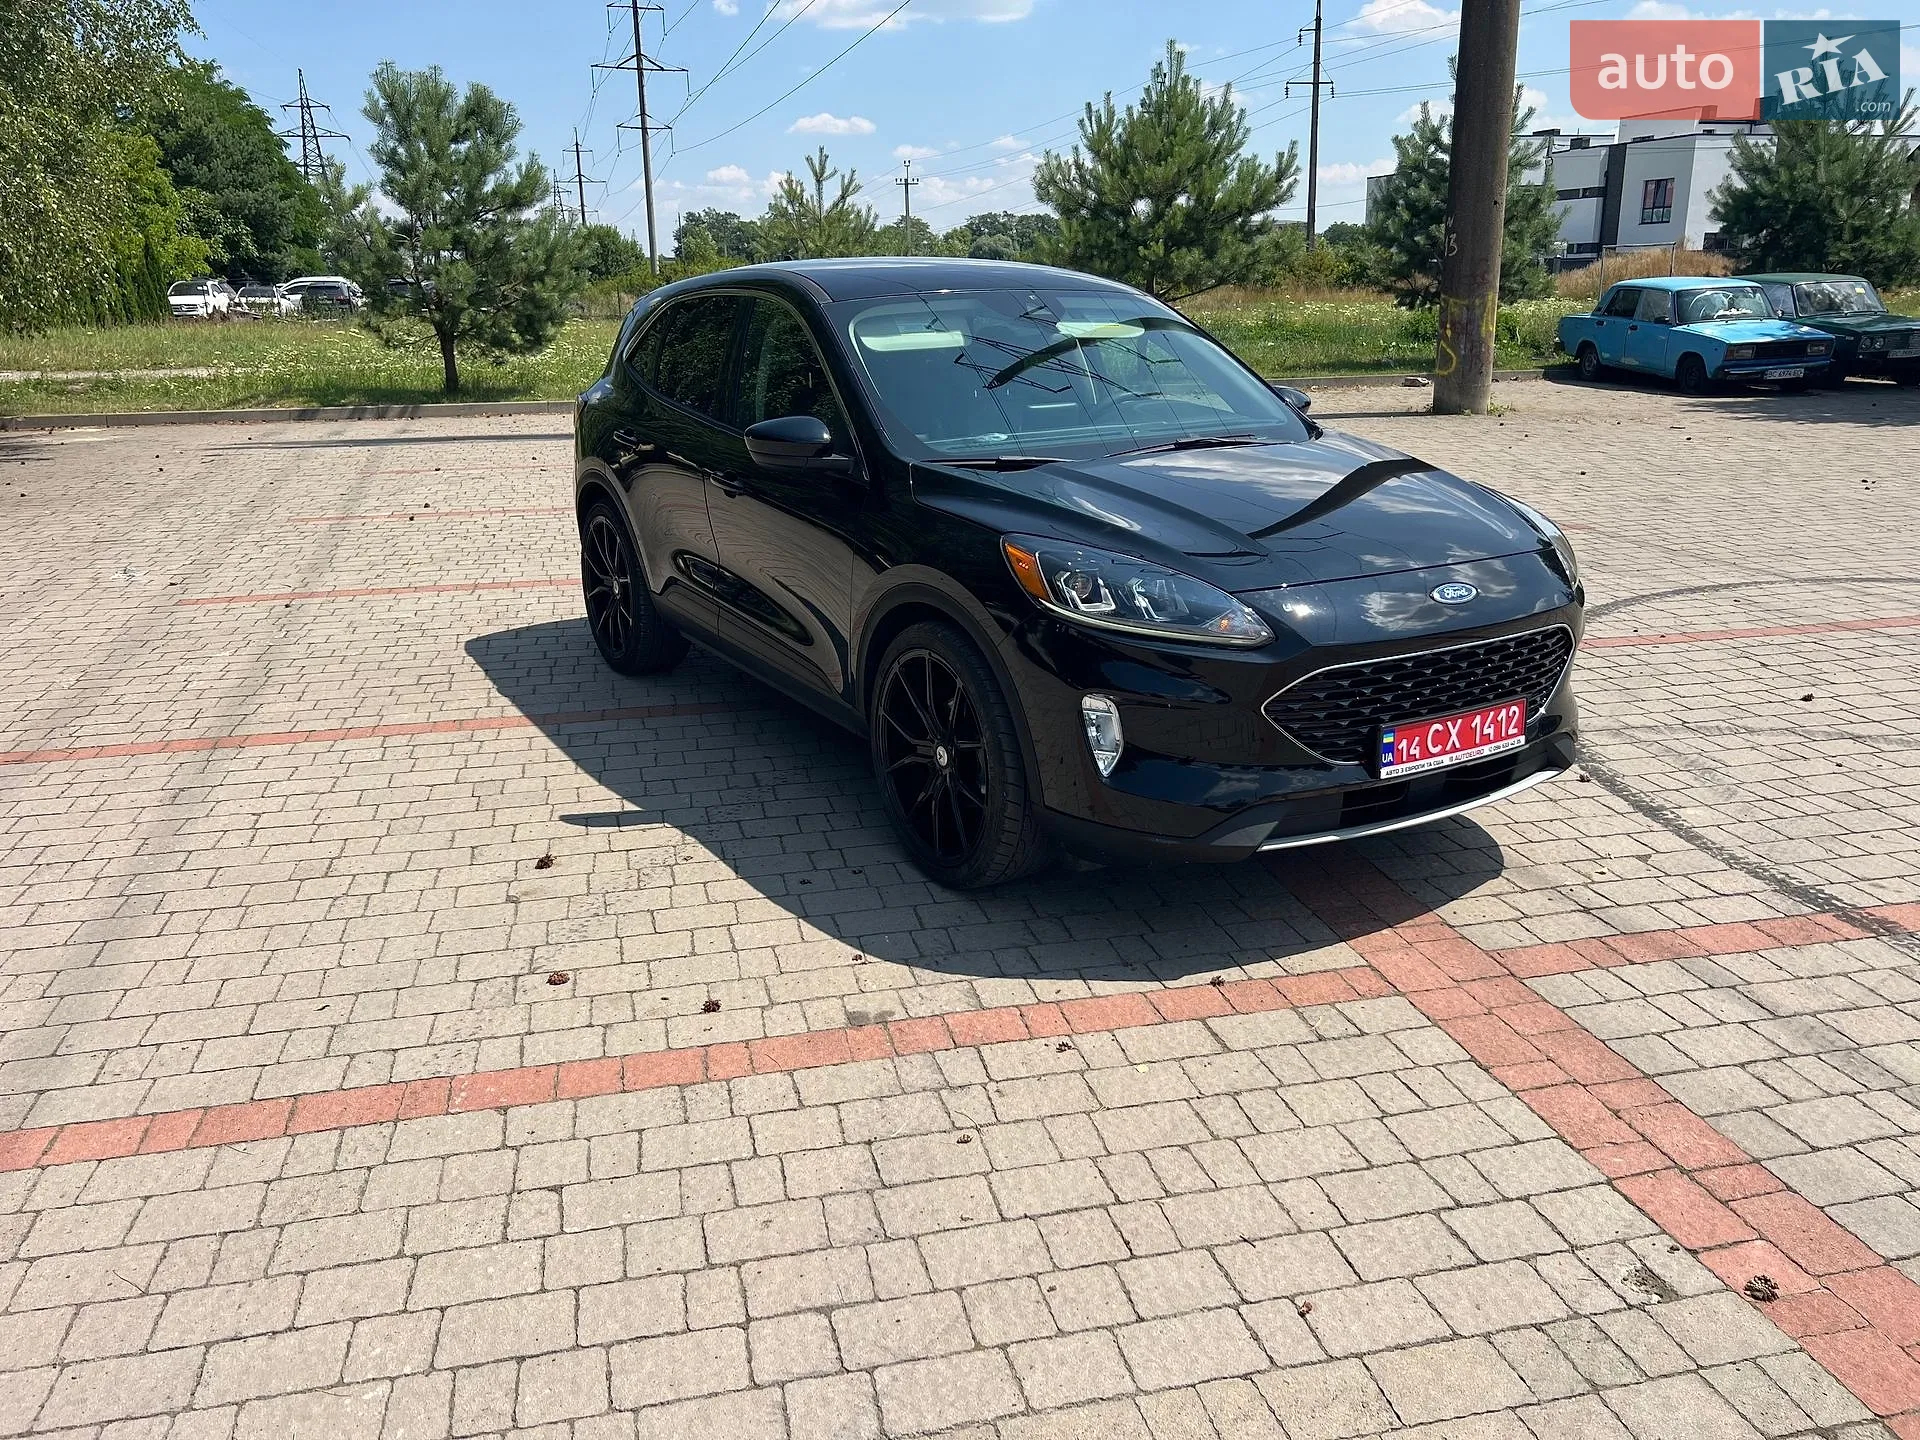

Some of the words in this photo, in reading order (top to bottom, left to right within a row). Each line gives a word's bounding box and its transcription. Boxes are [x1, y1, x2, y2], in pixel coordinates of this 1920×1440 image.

[1443, 585, 1469, 599] Ford
[1397, 736, 1421, 762] 14
[1426, 718, 1463, 754] CX
[1471, 705, 1520, 744] 1412
[1382, 752, 1394, 764] UA
[1454, 748, 1485, 761] AUTOEURO
[1385, 767, 1400, 777] АВТО
